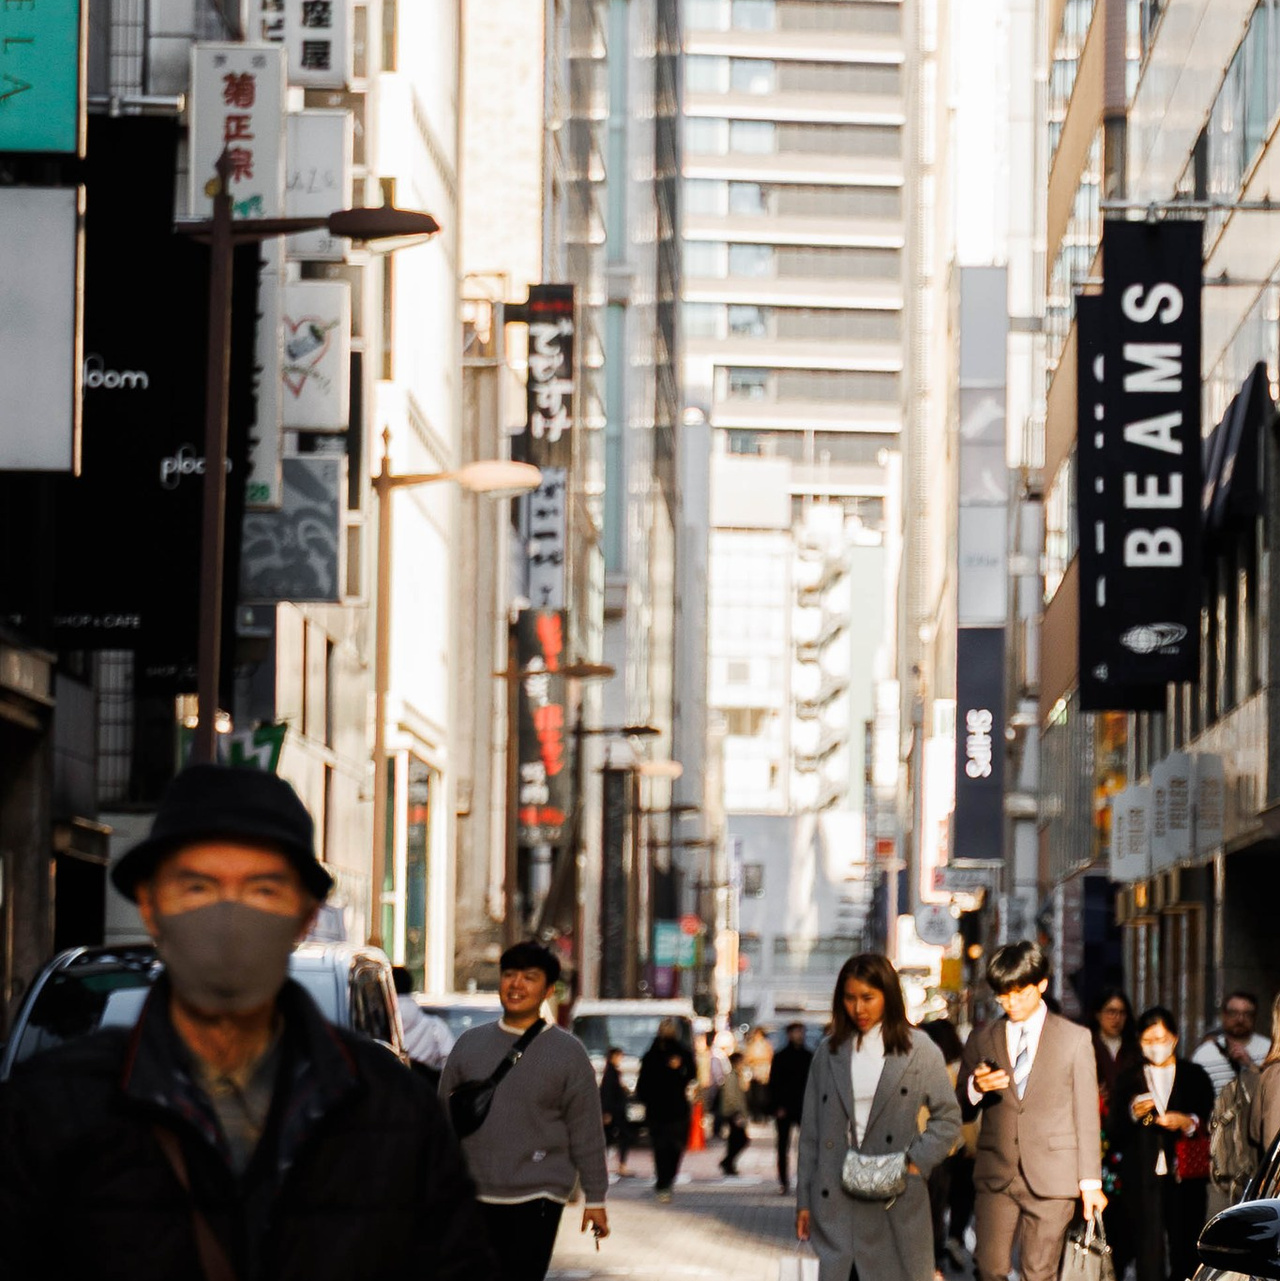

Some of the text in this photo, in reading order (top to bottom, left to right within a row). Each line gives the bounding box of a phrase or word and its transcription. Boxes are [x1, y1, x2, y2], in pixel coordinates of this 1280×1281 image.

[83, 353, 149, 394] loom
[1121, 281, 1184, 568] BEAMS
[965, 708, 993, 779] SHIPS
